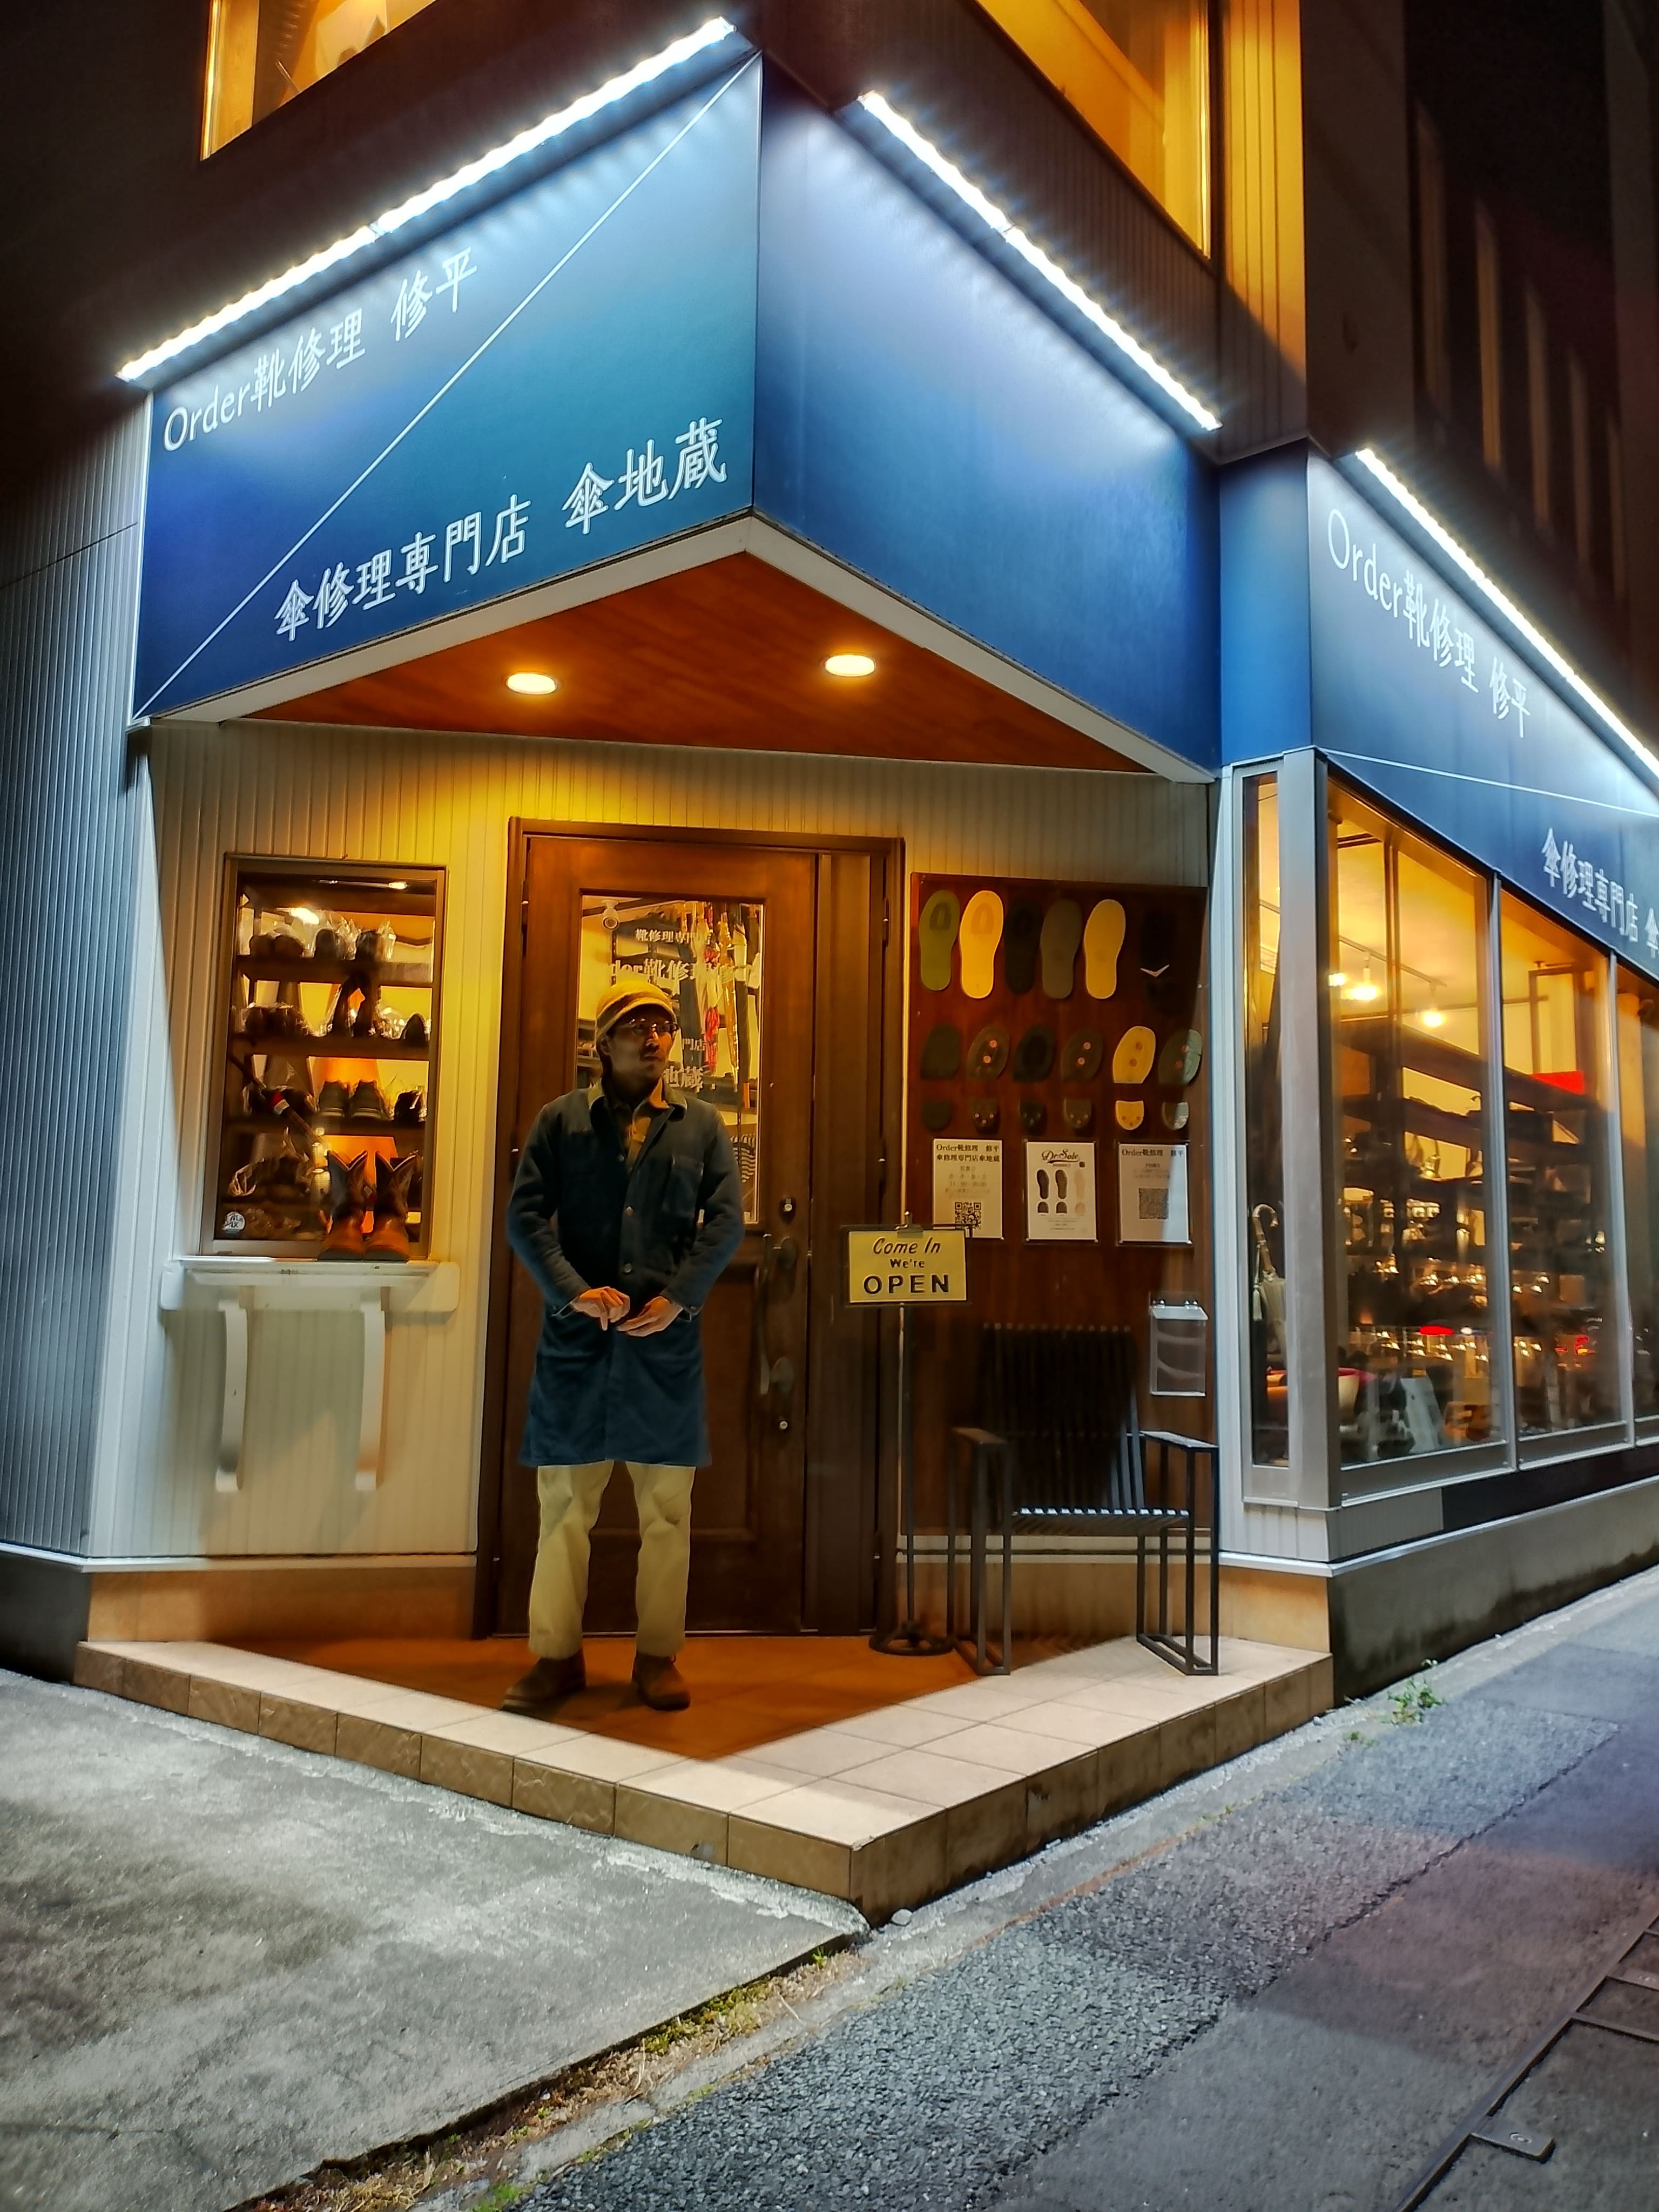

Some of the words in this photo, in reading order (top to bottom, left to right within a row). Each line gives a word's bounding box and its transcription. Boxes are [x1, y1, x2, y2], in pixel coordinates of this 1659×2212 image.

[164, 308, 366, 451] Order靴修理
[391, 247, 477, 341] 修平
[274, 494, 531, 642] 傘修理専門店
[562, 417, 727, 535] 傘地蔵
[1490, 656, 1531, 738] 修平
[1541, 827, 1638, 942] 傘修理専門店
[1644, 907, 1659, 958] 傘
[864, 1274, 949, 1294] OPEN
[873, 1236, 918, 1255] Come
[924, 1236, 941, 1253] In
[890, 1258, 925, 1268] We're
